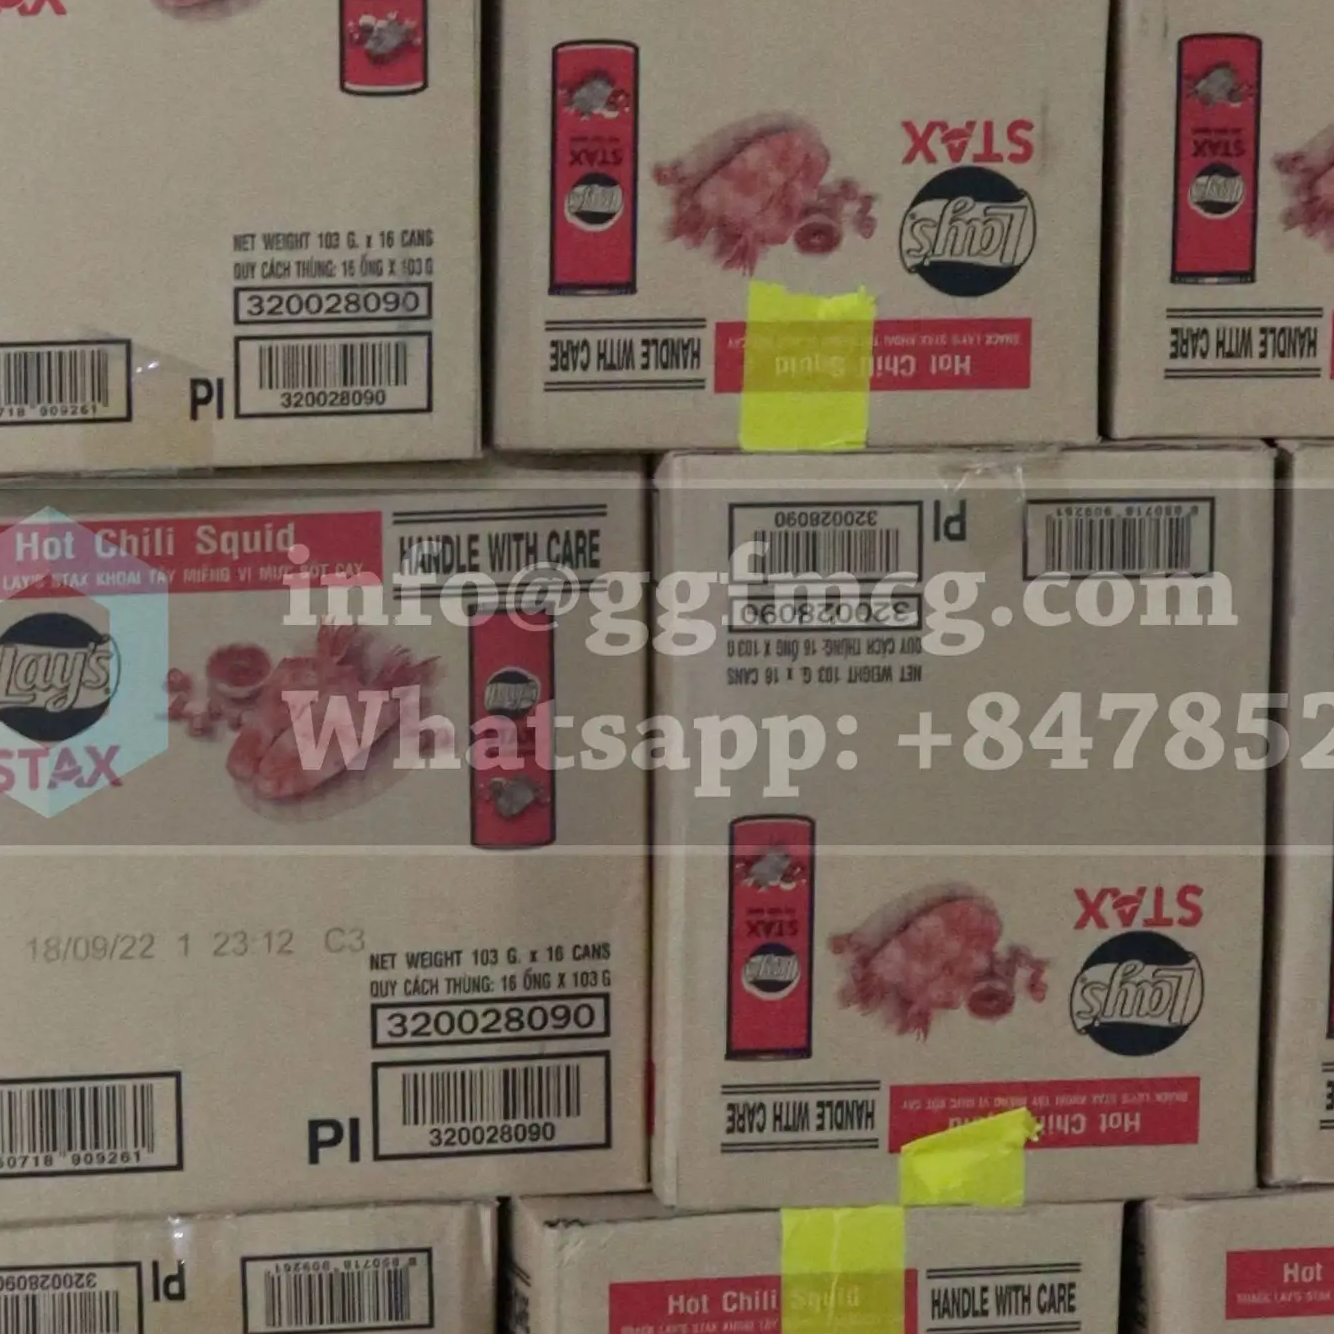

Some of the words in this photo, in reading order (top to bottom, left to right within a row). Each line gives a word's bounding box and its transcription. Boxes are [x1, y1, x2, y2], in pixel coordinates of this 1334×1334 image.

[904, 119, 1033, 163] STAX
[248, 291, 419, 316] 320028090
[16, 532, 74, 561] Hot
[94, 526, 175, 560] Chili
[195, 523, 295, 558] Squid
[1076, 884, 1201, 928] STAX
[370, 953, 396, 970] NET
[406, 951, 462, 968] WEIGHT
[473, 949, 498, 965] 103
[573, 943, 610, 961] CANS
[388, 1004, 595, 1037] 320028090
[308, 1118, 360, 1164] PI
[430, 1122, 555, 1146] 320028090
